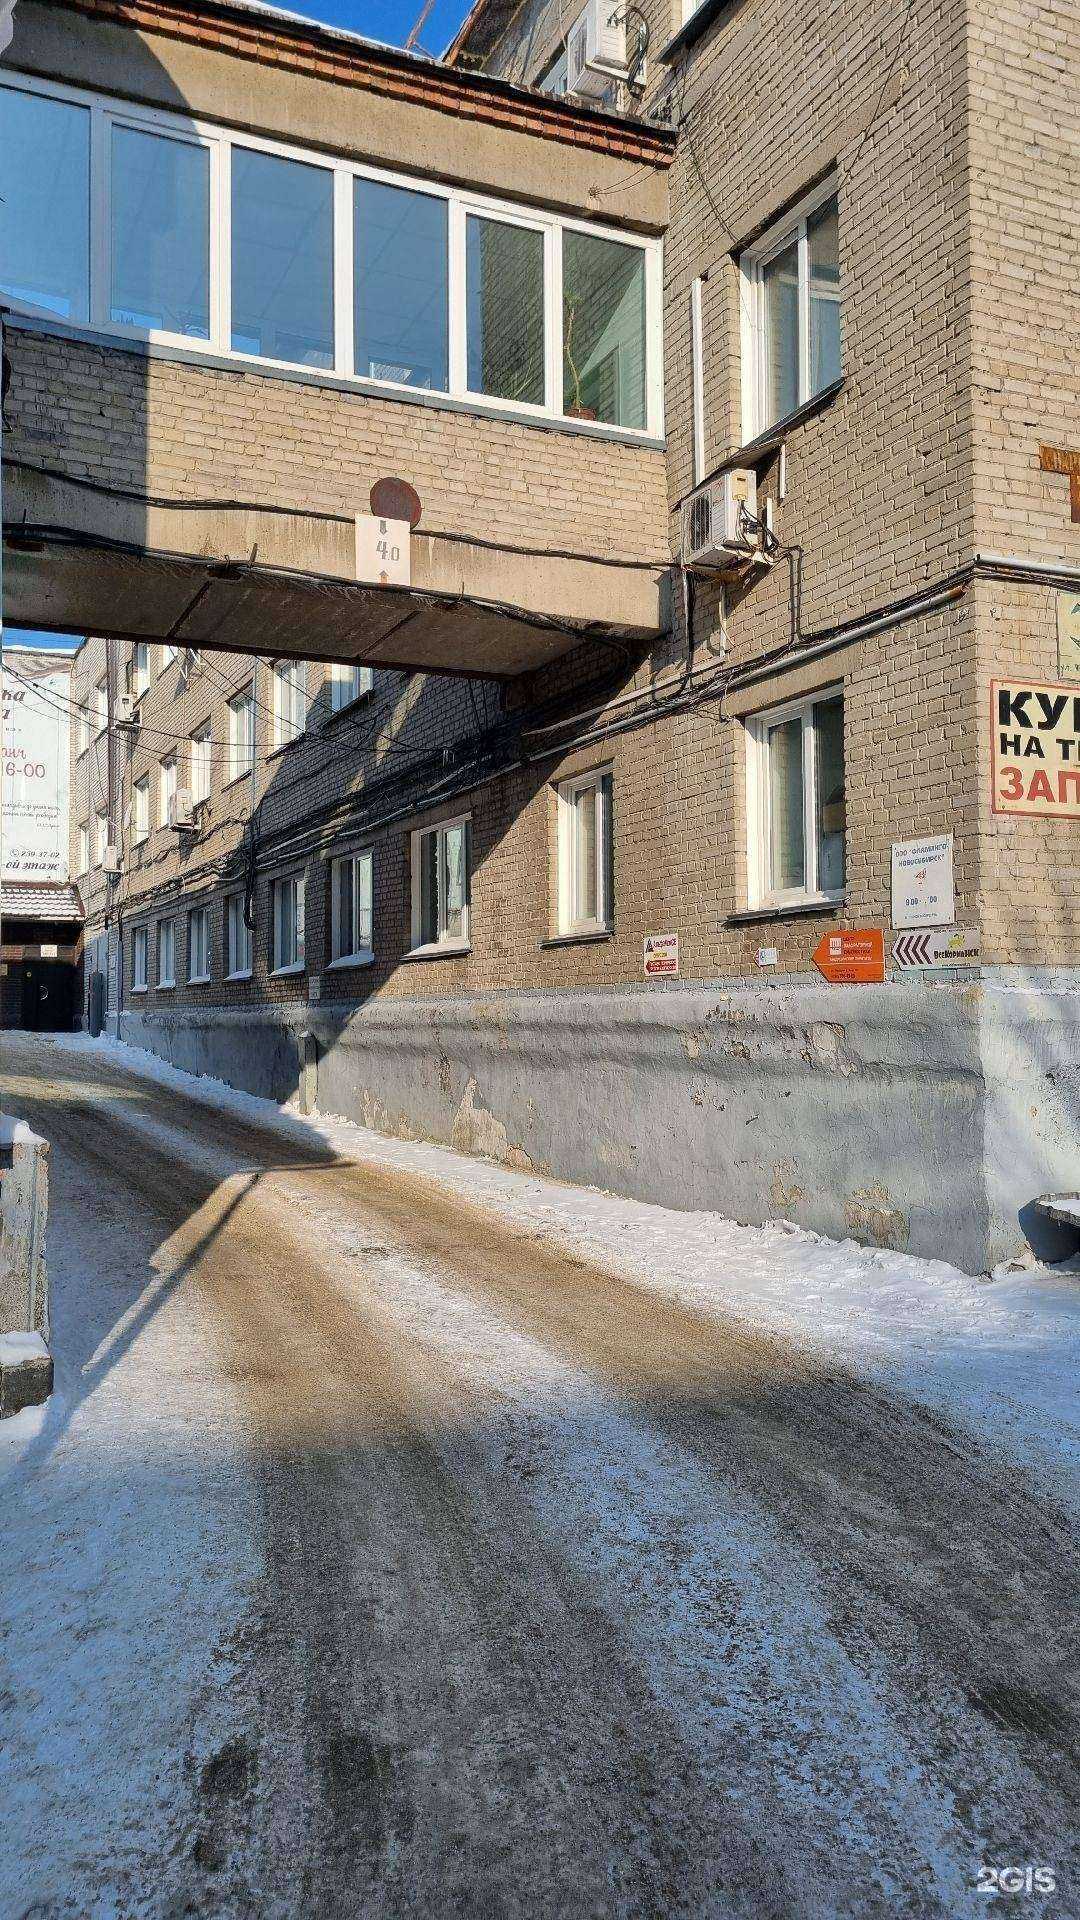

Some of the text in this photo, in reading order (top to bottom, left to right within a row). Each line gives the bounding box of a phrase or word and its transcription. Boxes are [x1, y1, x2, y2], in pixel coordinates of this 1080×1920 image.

[999, 690, 1080, 732] КУ
[1000, 733, 1080, 761] НА Т
[22, 862, 61, 871] этаж
